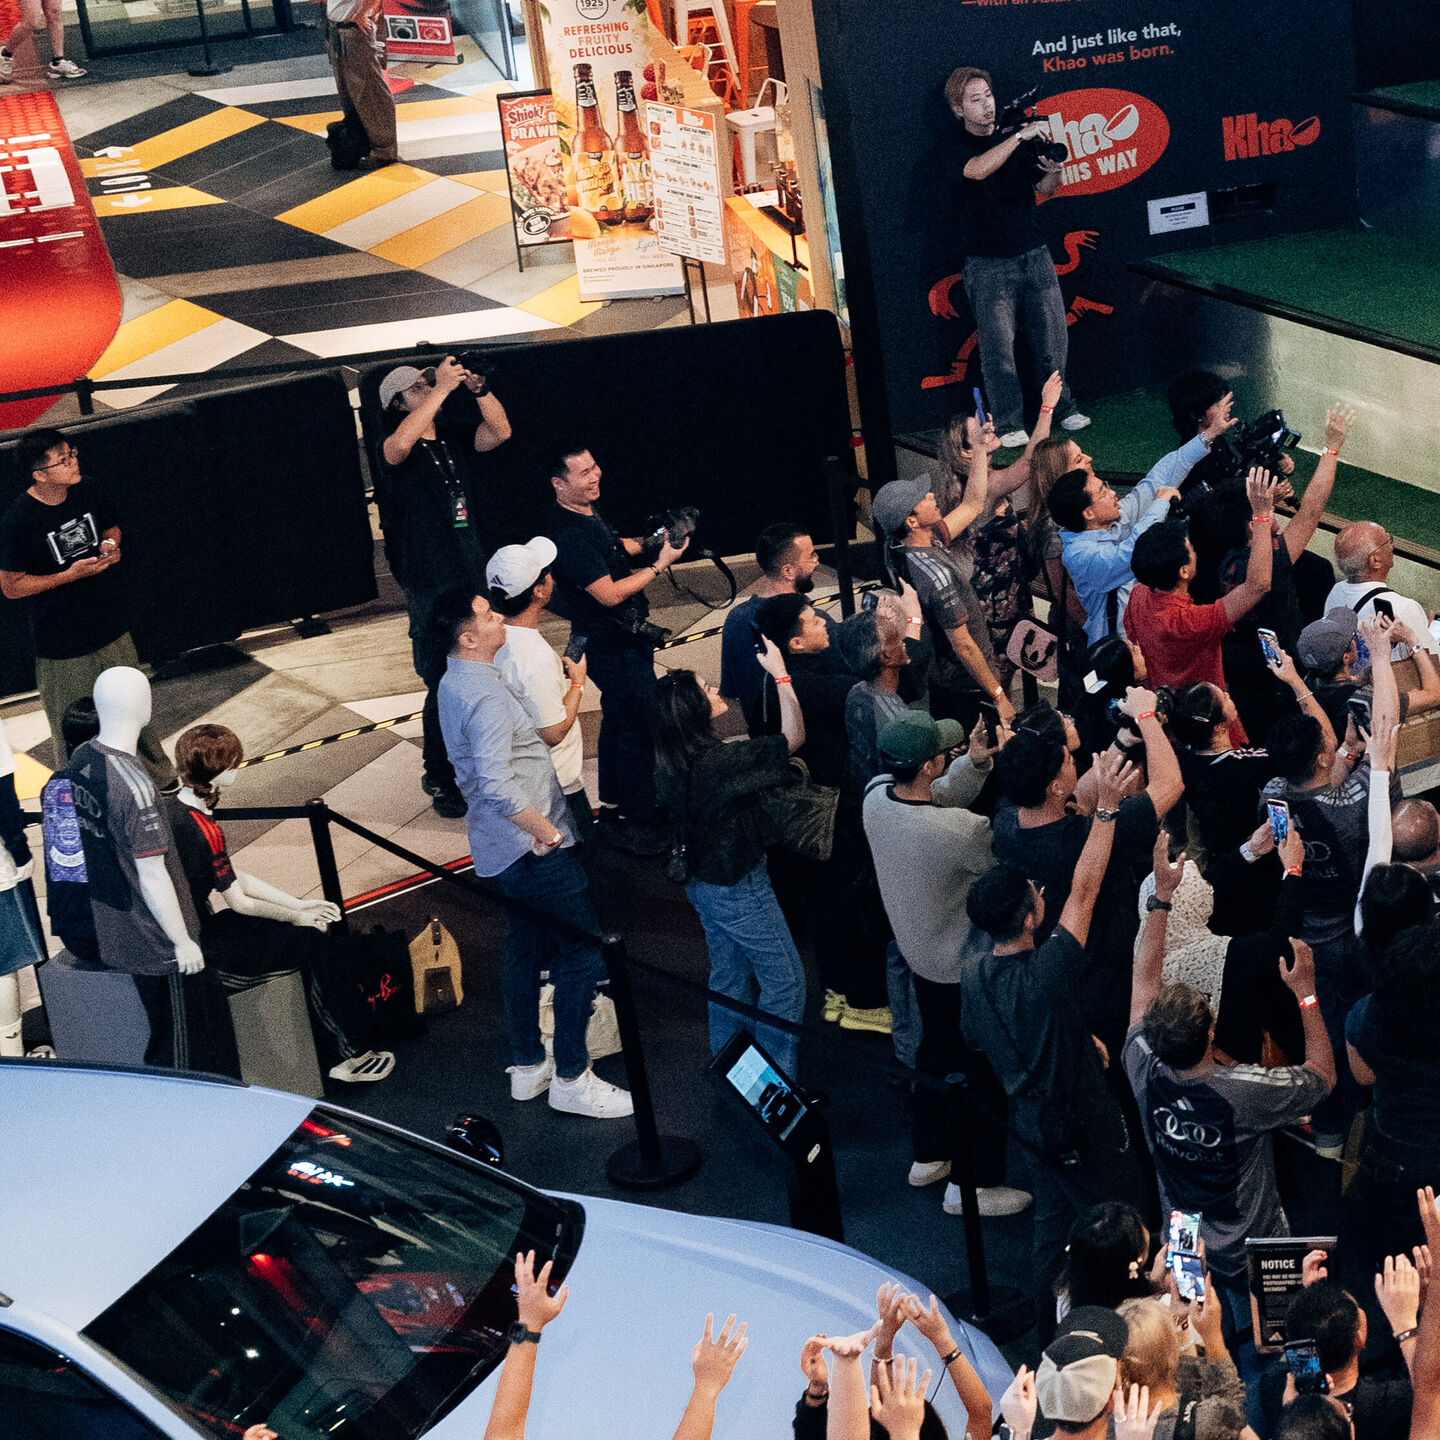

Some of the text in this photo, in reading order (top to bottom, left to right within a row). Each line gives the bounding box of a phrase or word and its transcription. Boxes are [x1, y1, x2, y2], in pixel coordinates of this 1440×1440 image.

[563, 21, 630, 37] REFRESHING
[577, 34, 620, 47] FRUITY
[1031, 20, 1183, 57] And just like that,
[569, 43, 633, 59] DELICIOUS
[1042, 44, 1175, 74] Khao was born.
[508, 105, 545, 124] Shiok!
[1062, 148, 1139, 187] HIS WAY
[1261, 1258, 1296, 1270] NOTICE
